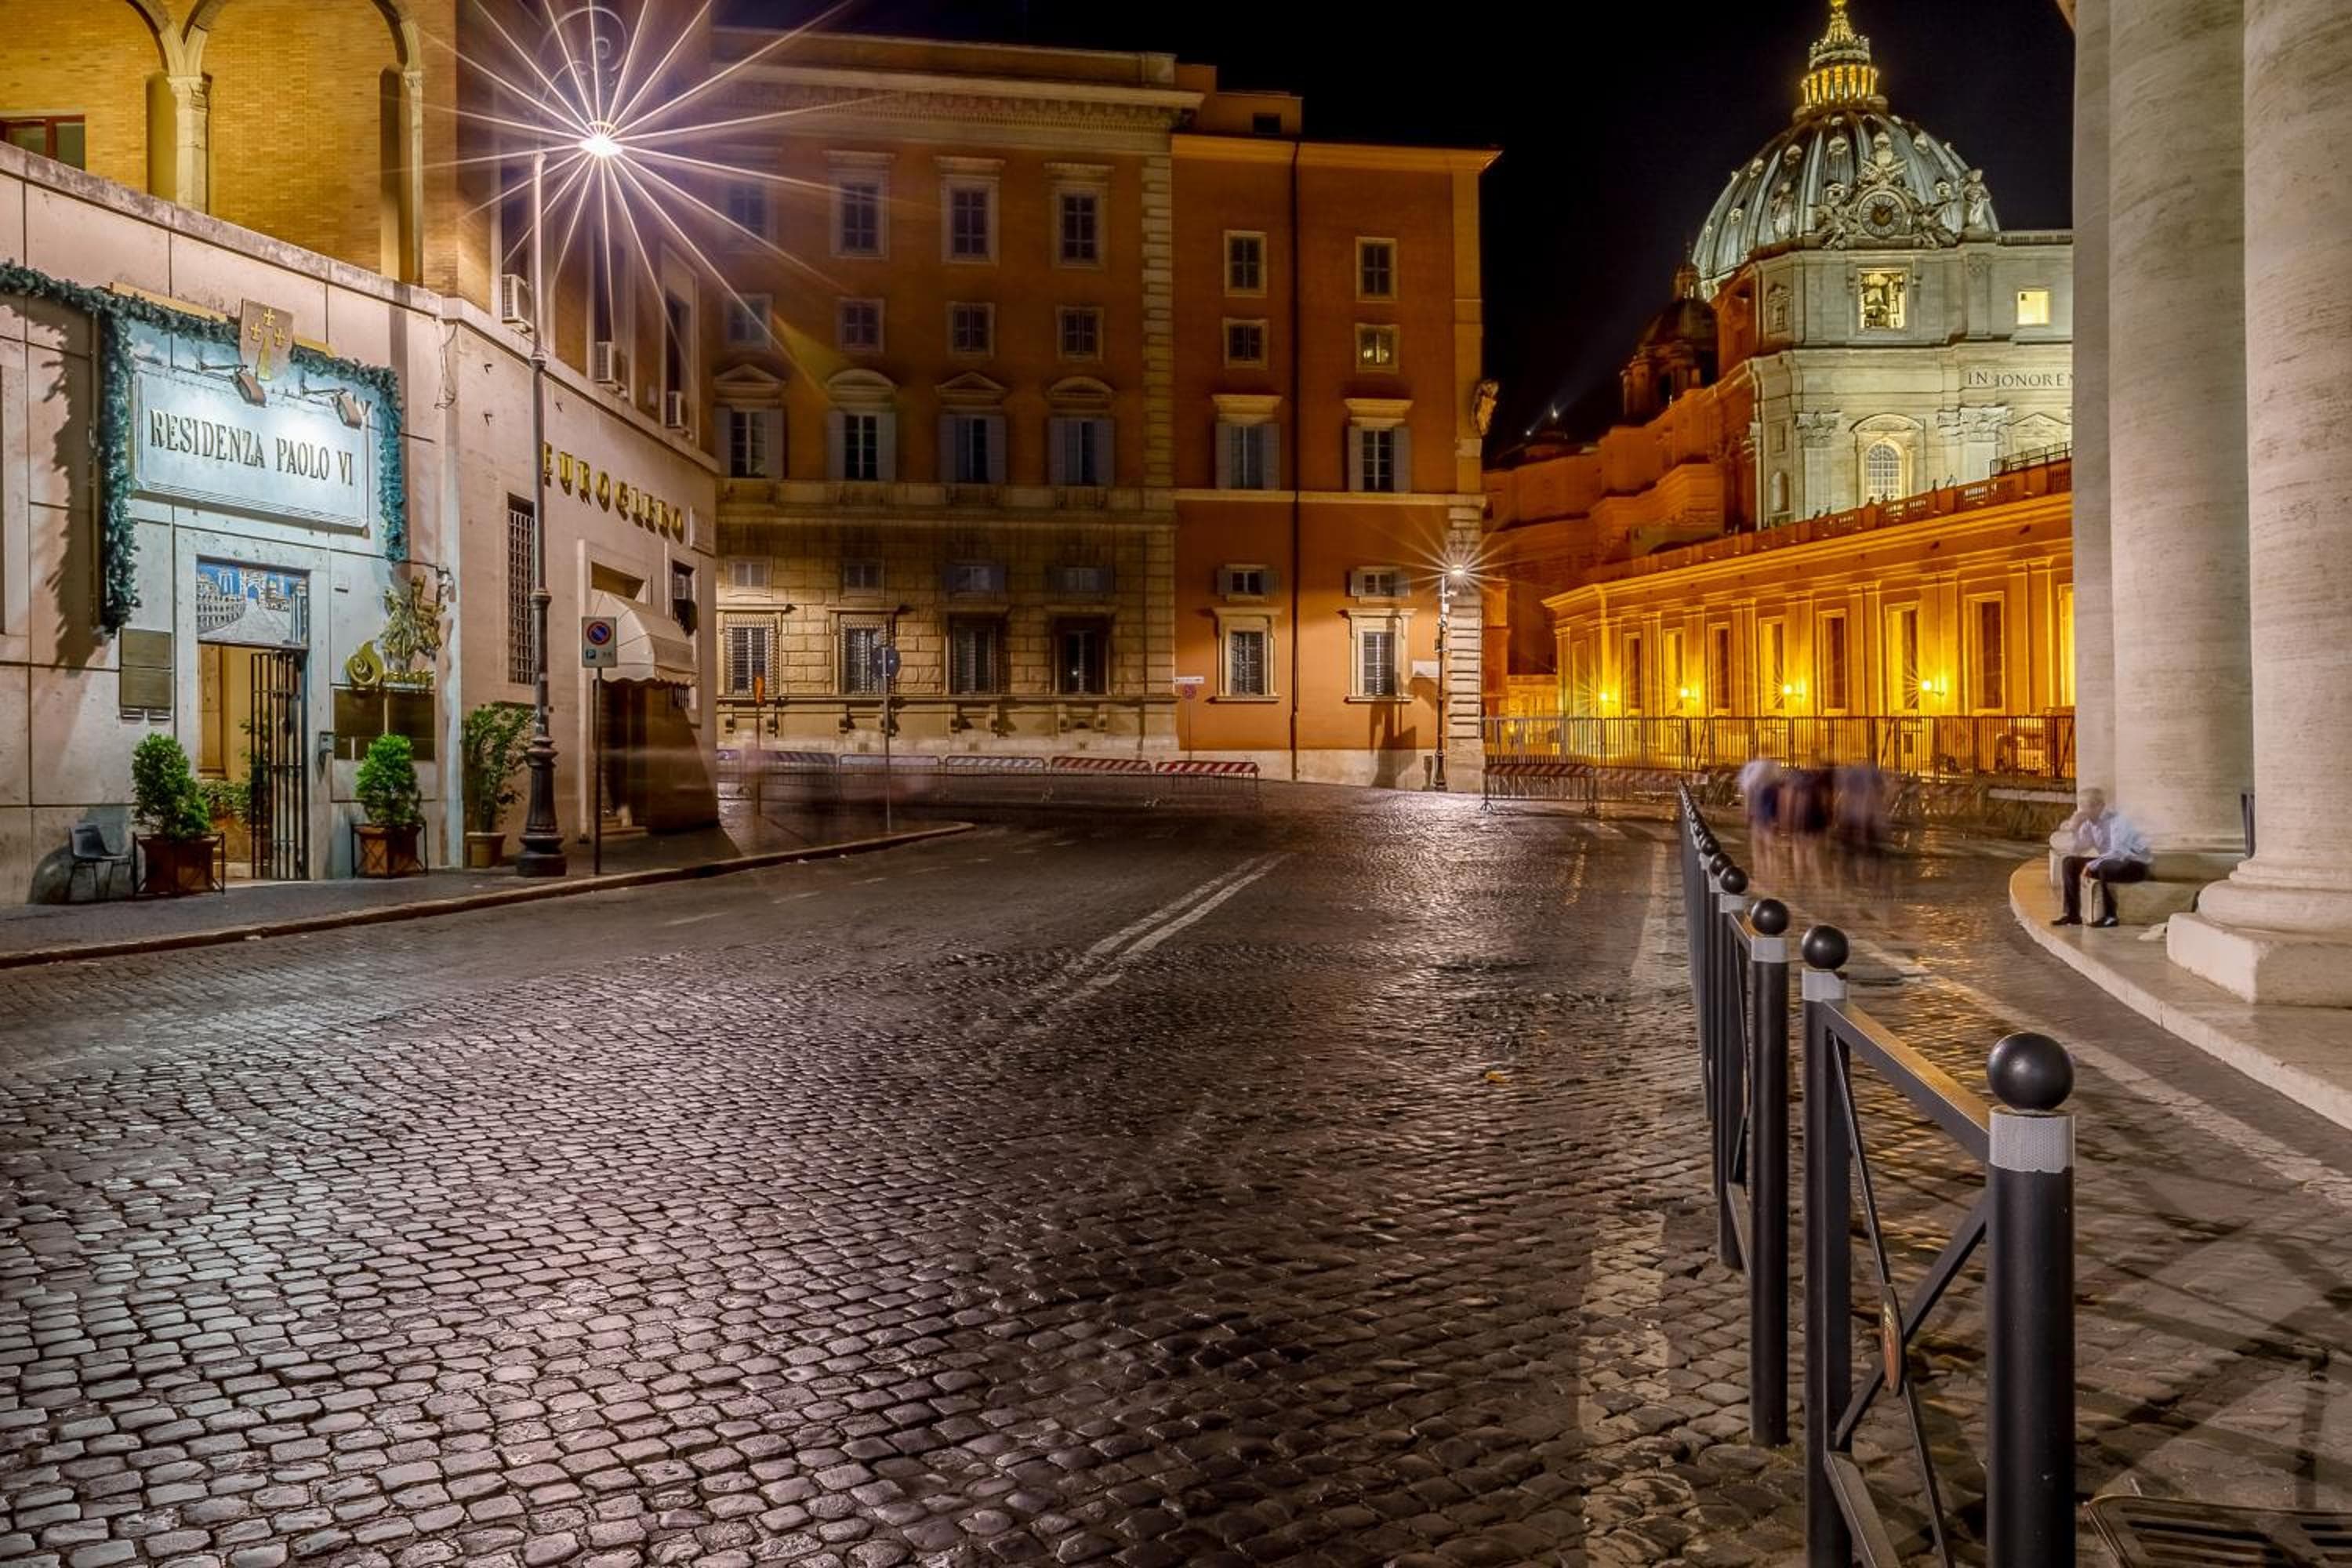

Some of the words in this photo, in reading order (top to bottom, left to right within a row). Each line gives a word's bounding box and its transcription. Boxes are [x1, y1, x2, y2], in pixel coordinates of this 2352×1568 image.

[1968, 371, 1988, 385] IN
[150, 410, 266, 469] RESIDENZA
[276, 437, 330, 481] PAOLO
[337, 451, 353, 486] VI
